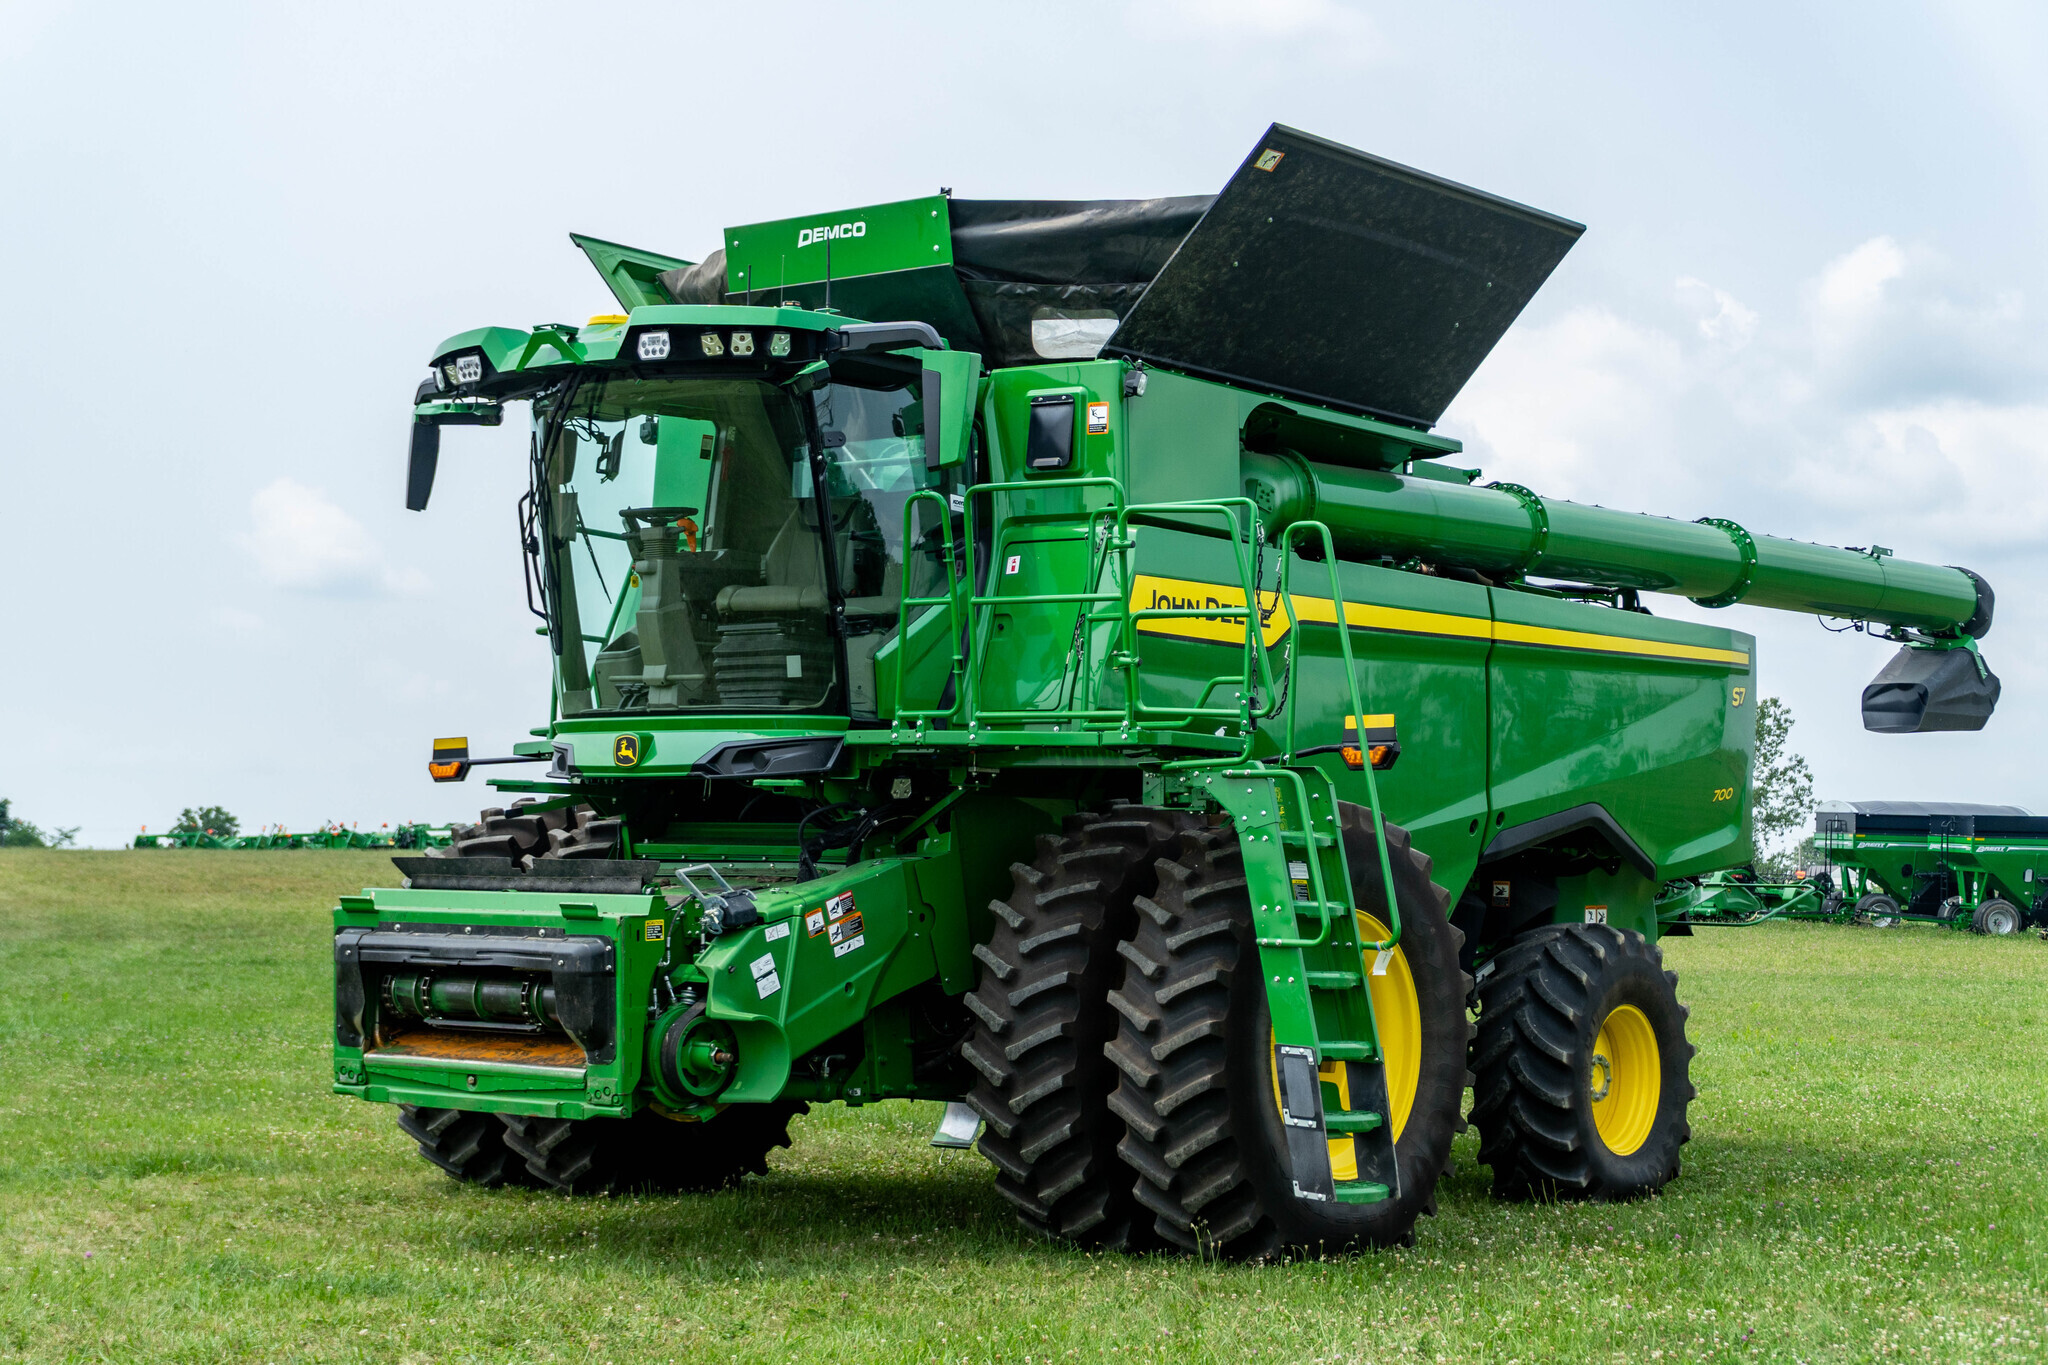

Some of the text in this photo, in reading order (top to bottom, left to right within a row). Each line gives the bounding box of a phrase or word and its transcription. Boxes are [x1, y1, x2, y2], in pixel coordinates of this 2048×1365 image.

[797, 221, 866, 248] DEMCO
[1732, 687, 1746, 707] S7
[1712, 787, 1734, 802] 700
